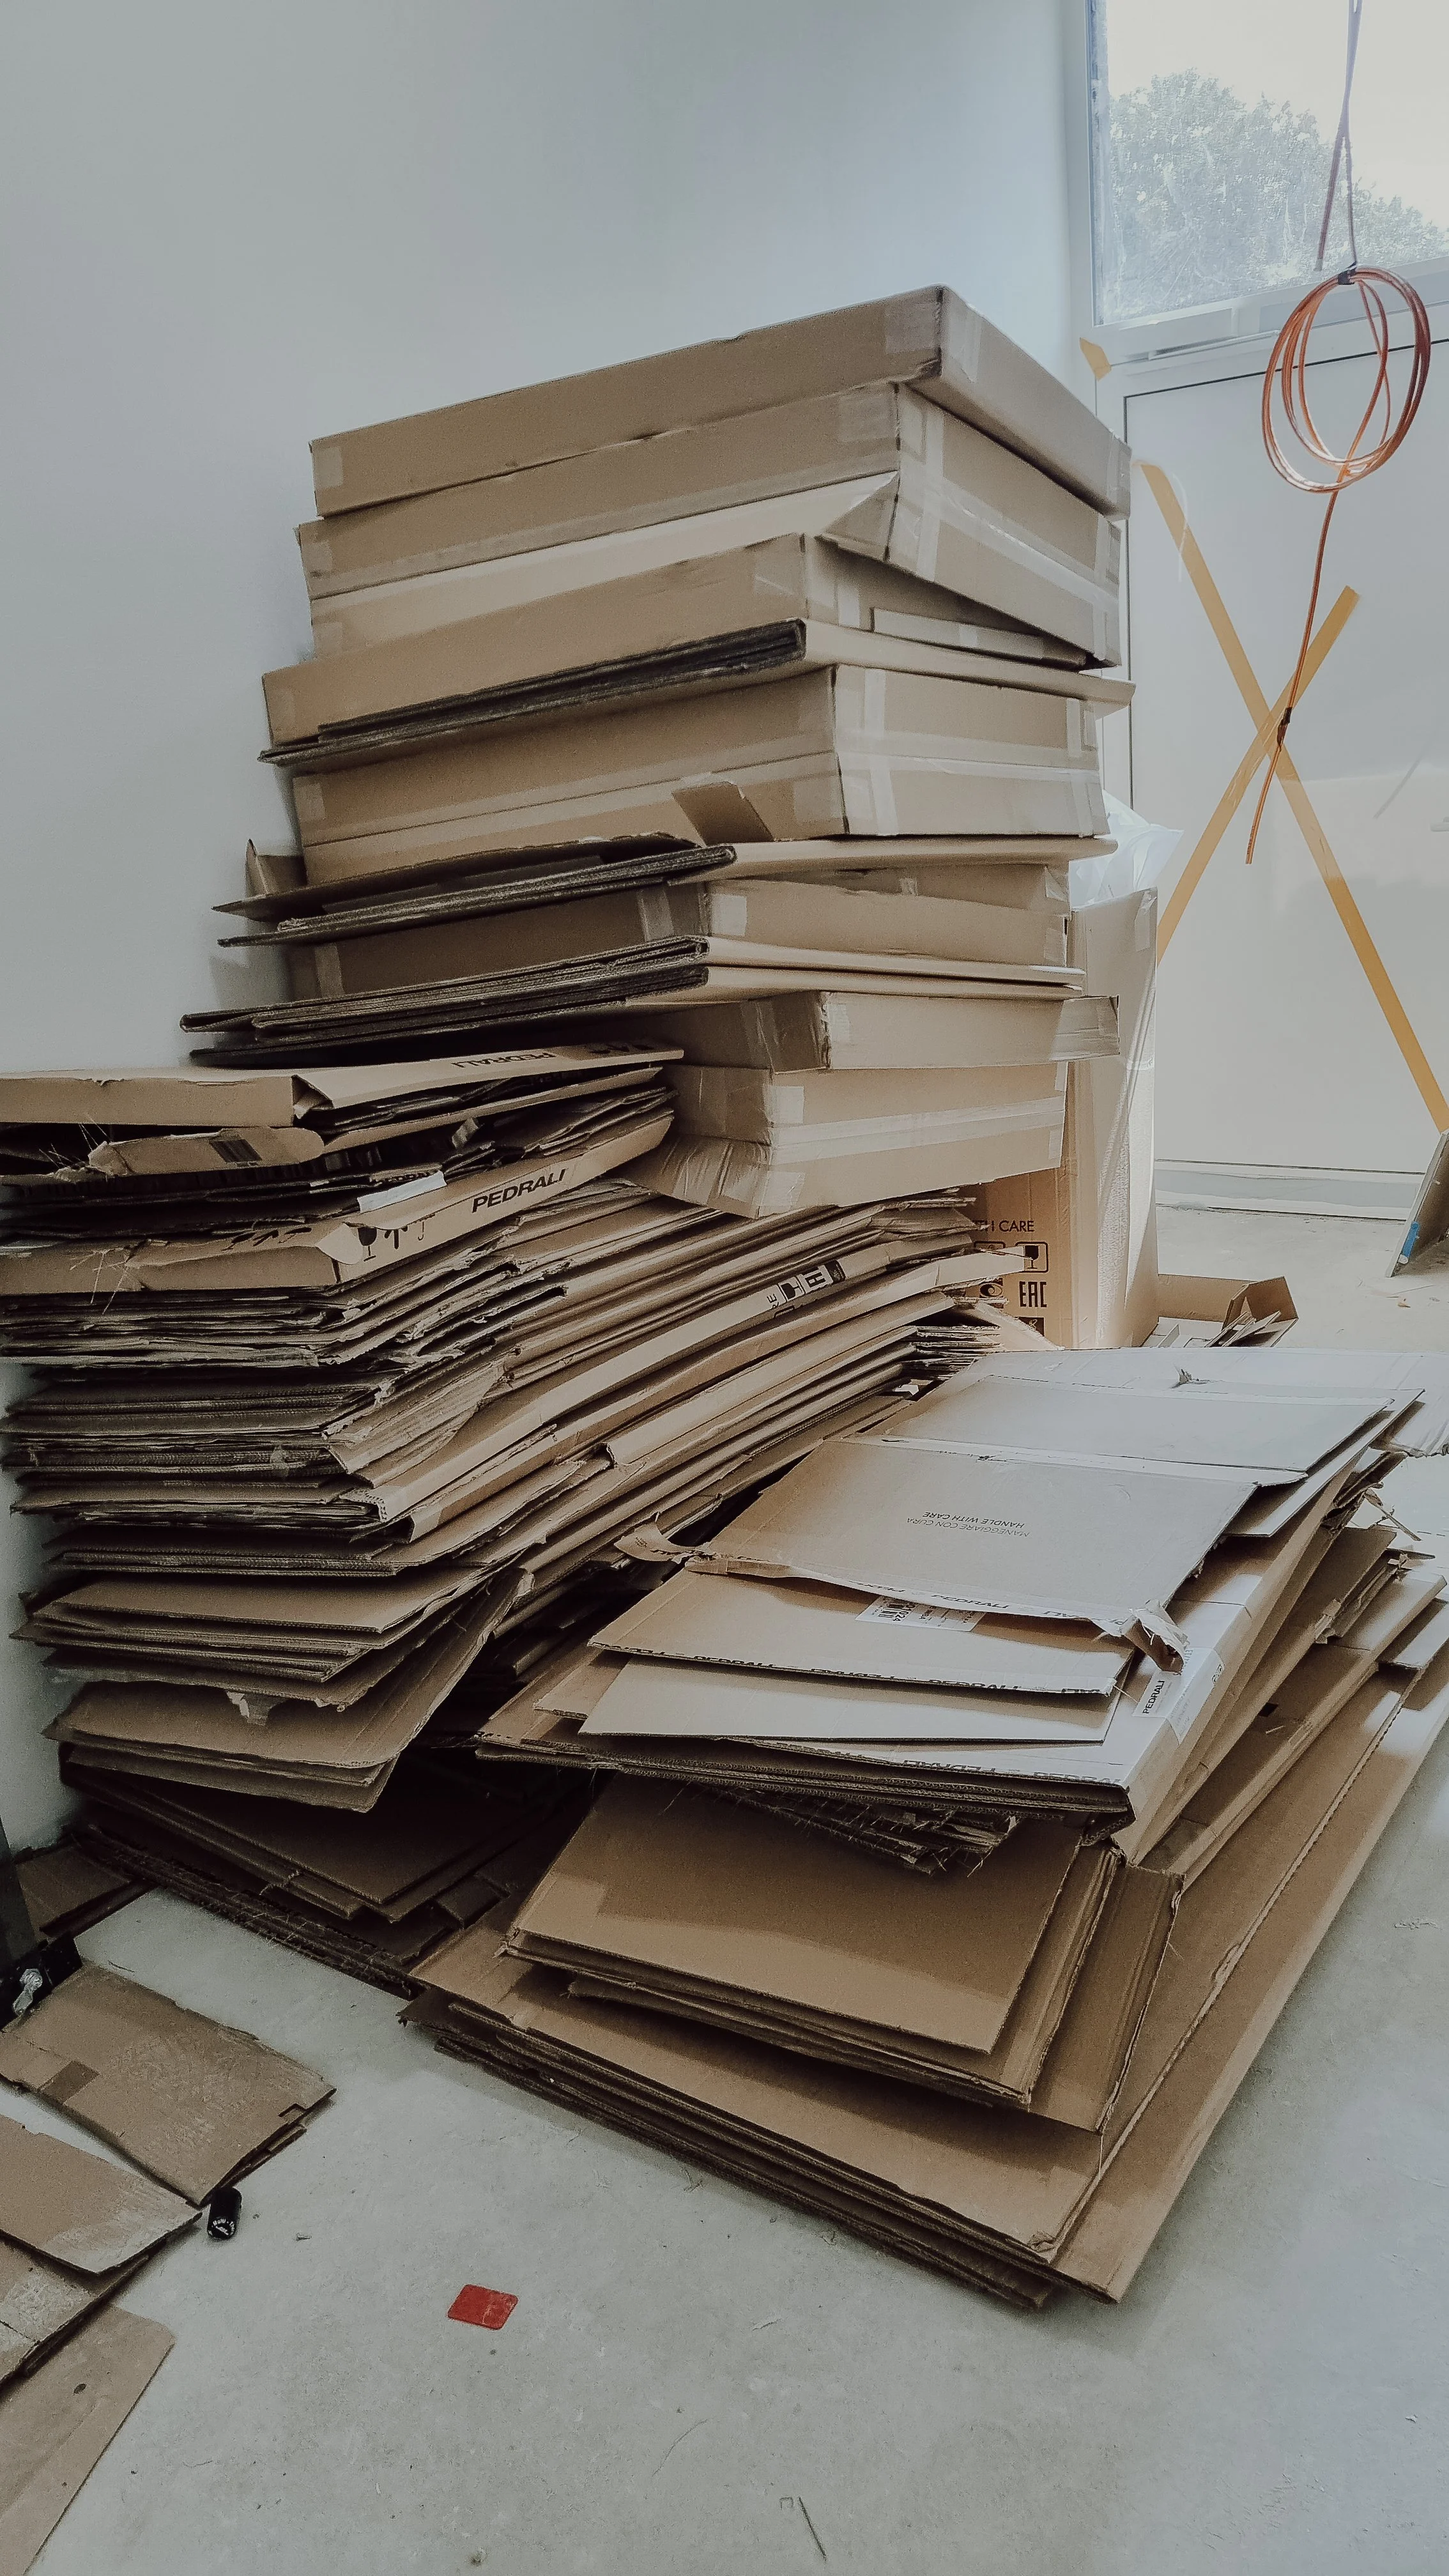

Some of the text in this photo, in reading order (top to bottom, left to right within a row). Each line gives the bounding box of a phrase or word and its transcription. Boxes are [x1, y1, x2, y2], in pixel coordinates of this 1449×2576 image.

[451, 1052, 556, 1068] PEDRALI
[471, 1169, 566, 1213] PEDRALI
[999, 1220, 1035, 1232] CARE
[1019, 1280, 1048, 1308] EAC
[907, 1517, 934, 1526] CURA
[951, 1515, 979, 1523] WITH
[981, 1518, 1025, 1528] HANDLE
[960, 1524, 1031, 1537] MANEGGIARE
[1142, 1680, 1165, 1714] PEDRALI
